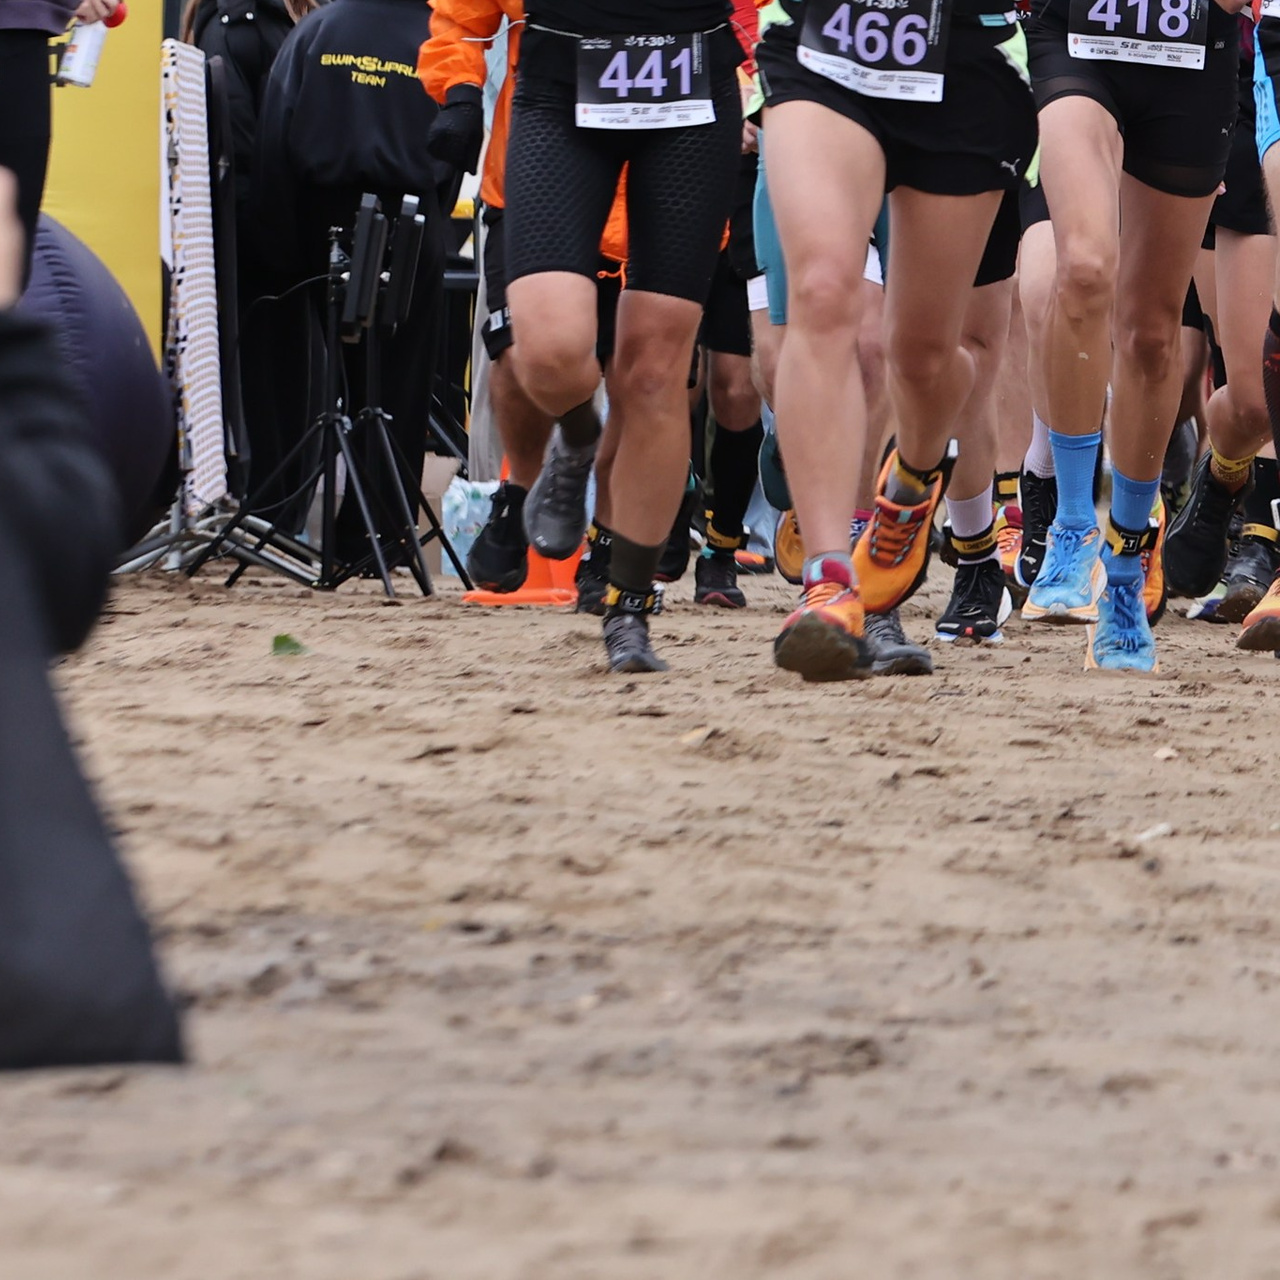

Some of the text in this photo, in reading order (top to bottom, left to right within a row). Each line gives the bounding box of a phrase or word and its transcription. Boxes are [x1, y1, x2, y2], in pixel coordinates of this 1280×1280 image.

[822, 2, 929, 66] 466
[321, 53, 421, 80] SWIMSUPRU
[351, 70, 386, 88] TEAM
[598, 47, 691, 98] 441
